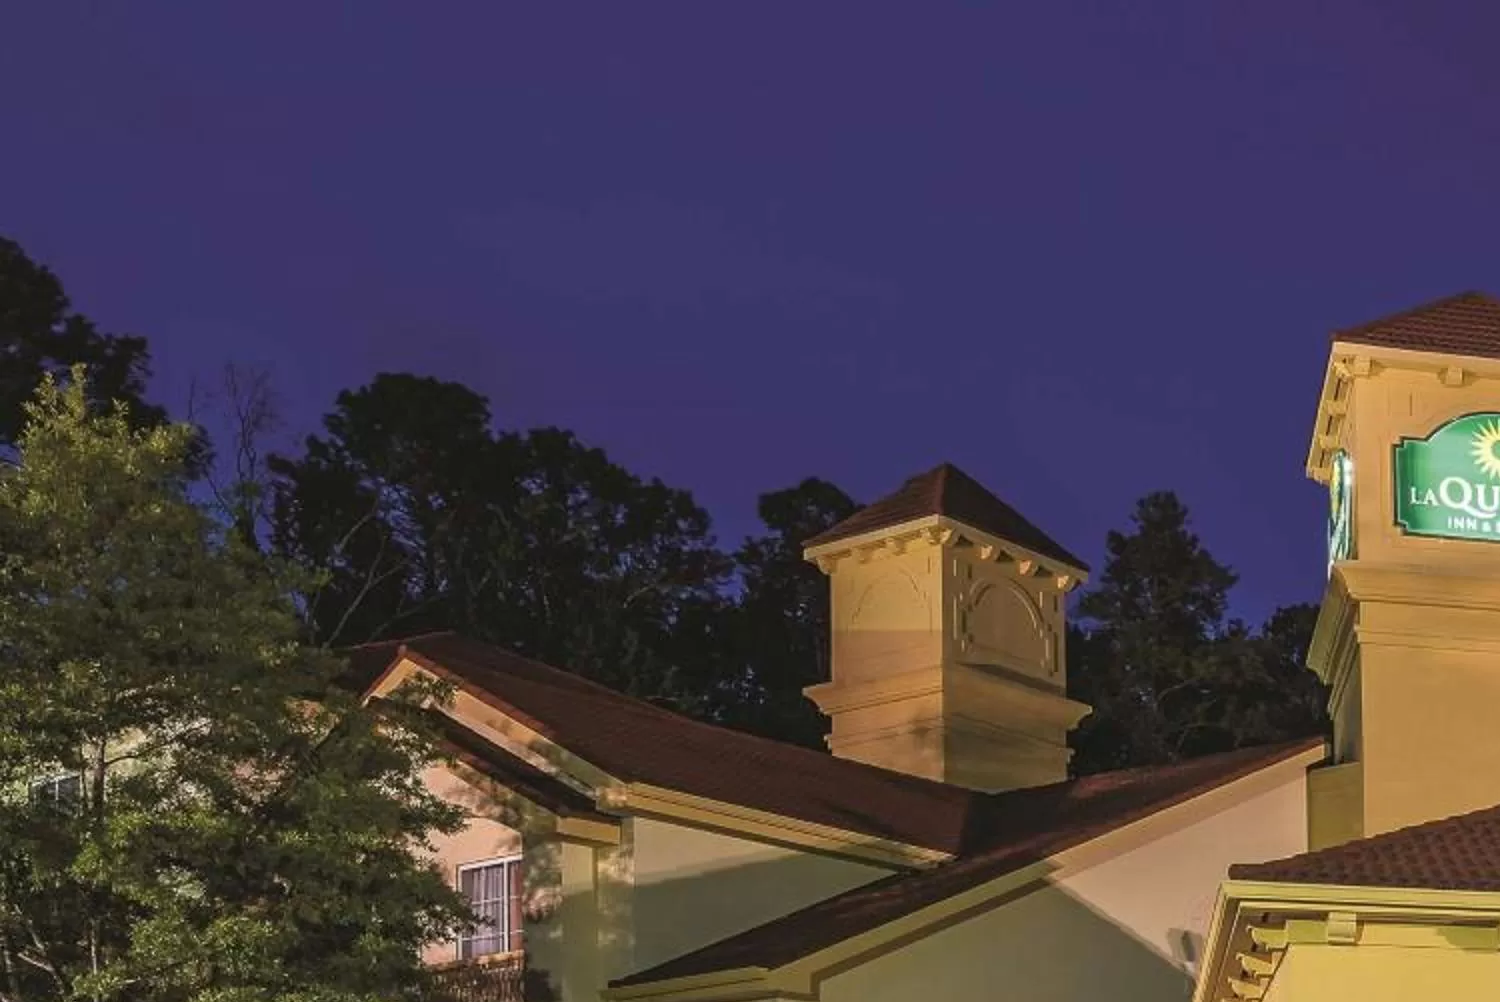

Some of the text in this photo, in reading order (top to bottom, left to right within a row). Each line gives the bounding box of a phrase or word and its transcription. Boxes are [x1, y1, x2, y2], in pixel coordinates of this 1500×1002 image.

[1410, 487, 1439, 506] LA
[1448, 516, 1477, 531] INN
[1481, 521, 1492, 533] &
